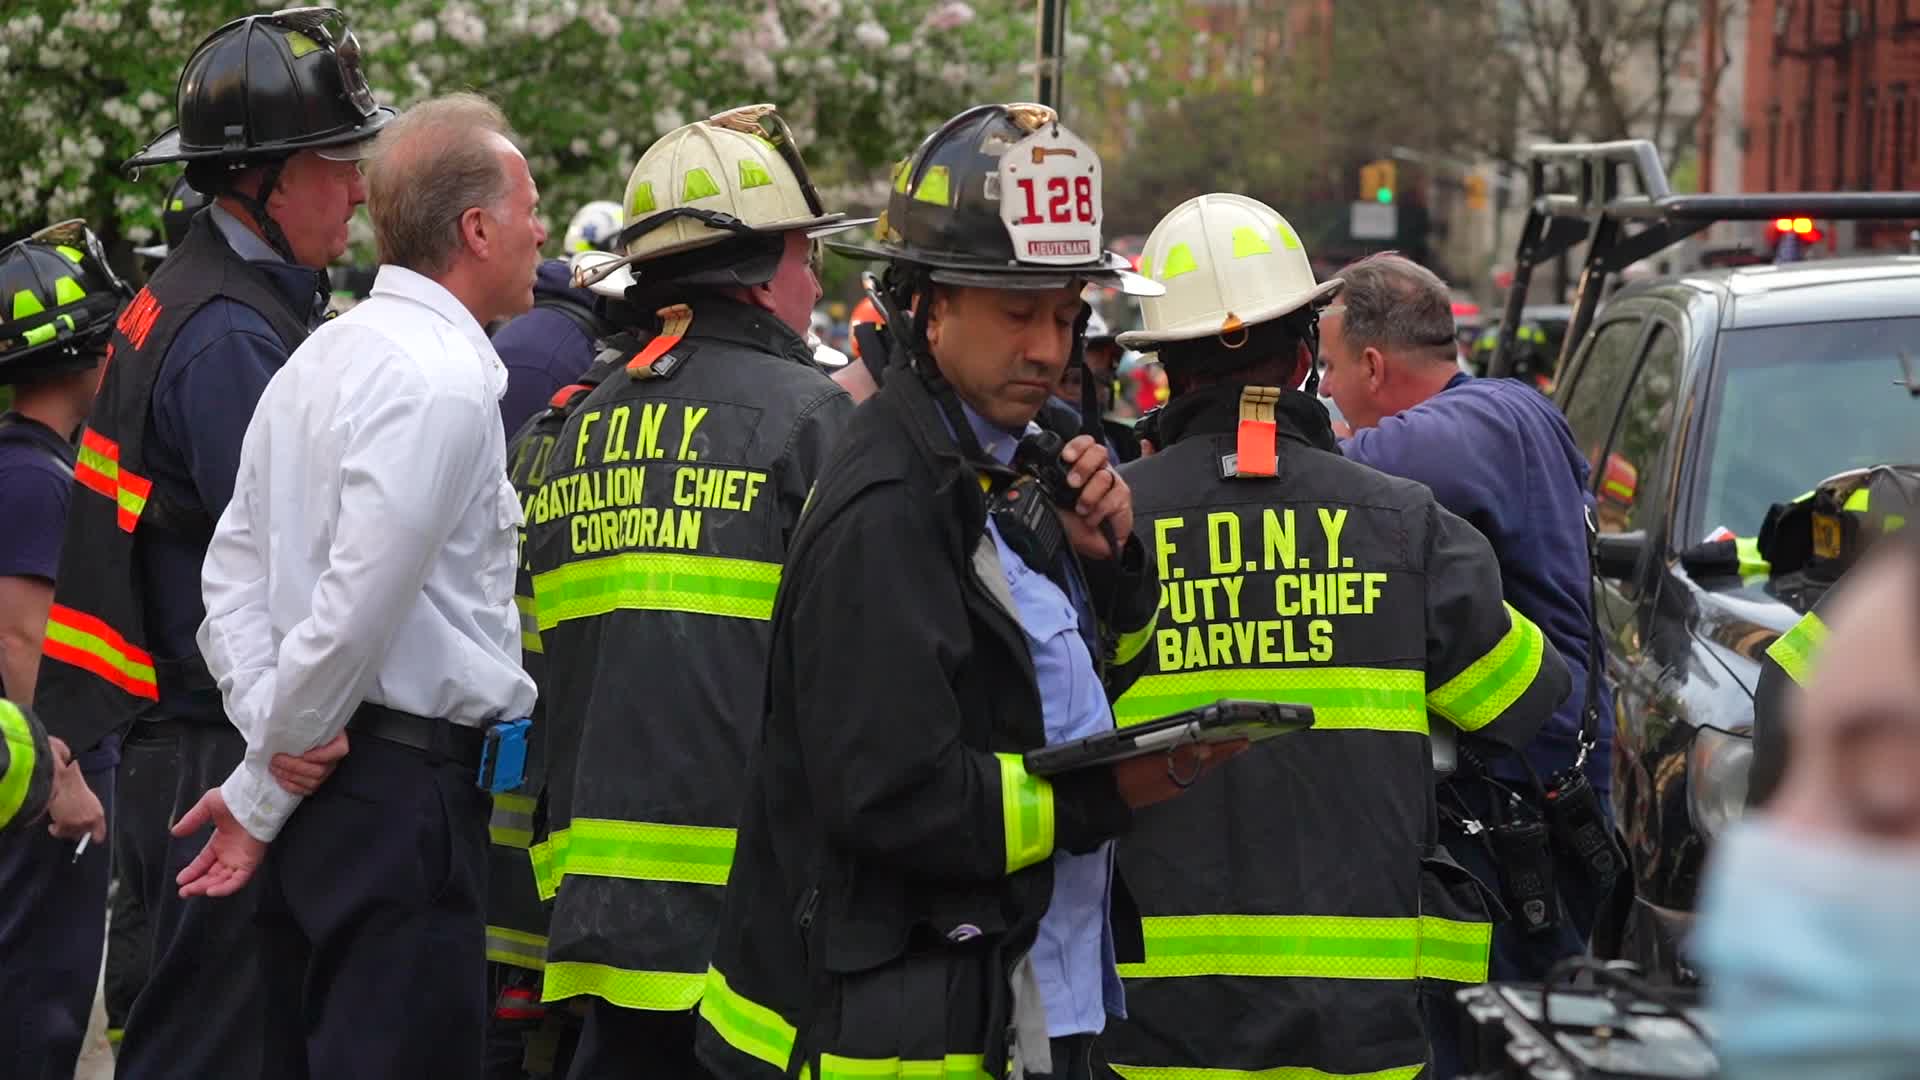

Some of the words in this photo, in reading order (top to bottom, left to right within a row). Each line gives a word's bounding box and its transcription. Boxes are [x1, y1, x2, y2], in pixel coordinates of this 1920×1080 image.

[1017, 176, 1093, 225] 128
[1029, 240, 1090, 255] LIEUTENANT
[535, 466, 646, 524] BATTALION
[673, 467, 767, 512] CHIEF
[571, 507, 702, 554] CORCORAN
[1275, 572, 1388, 617] CHIEF
[1157, 619, 1333, 672] BARVELS
